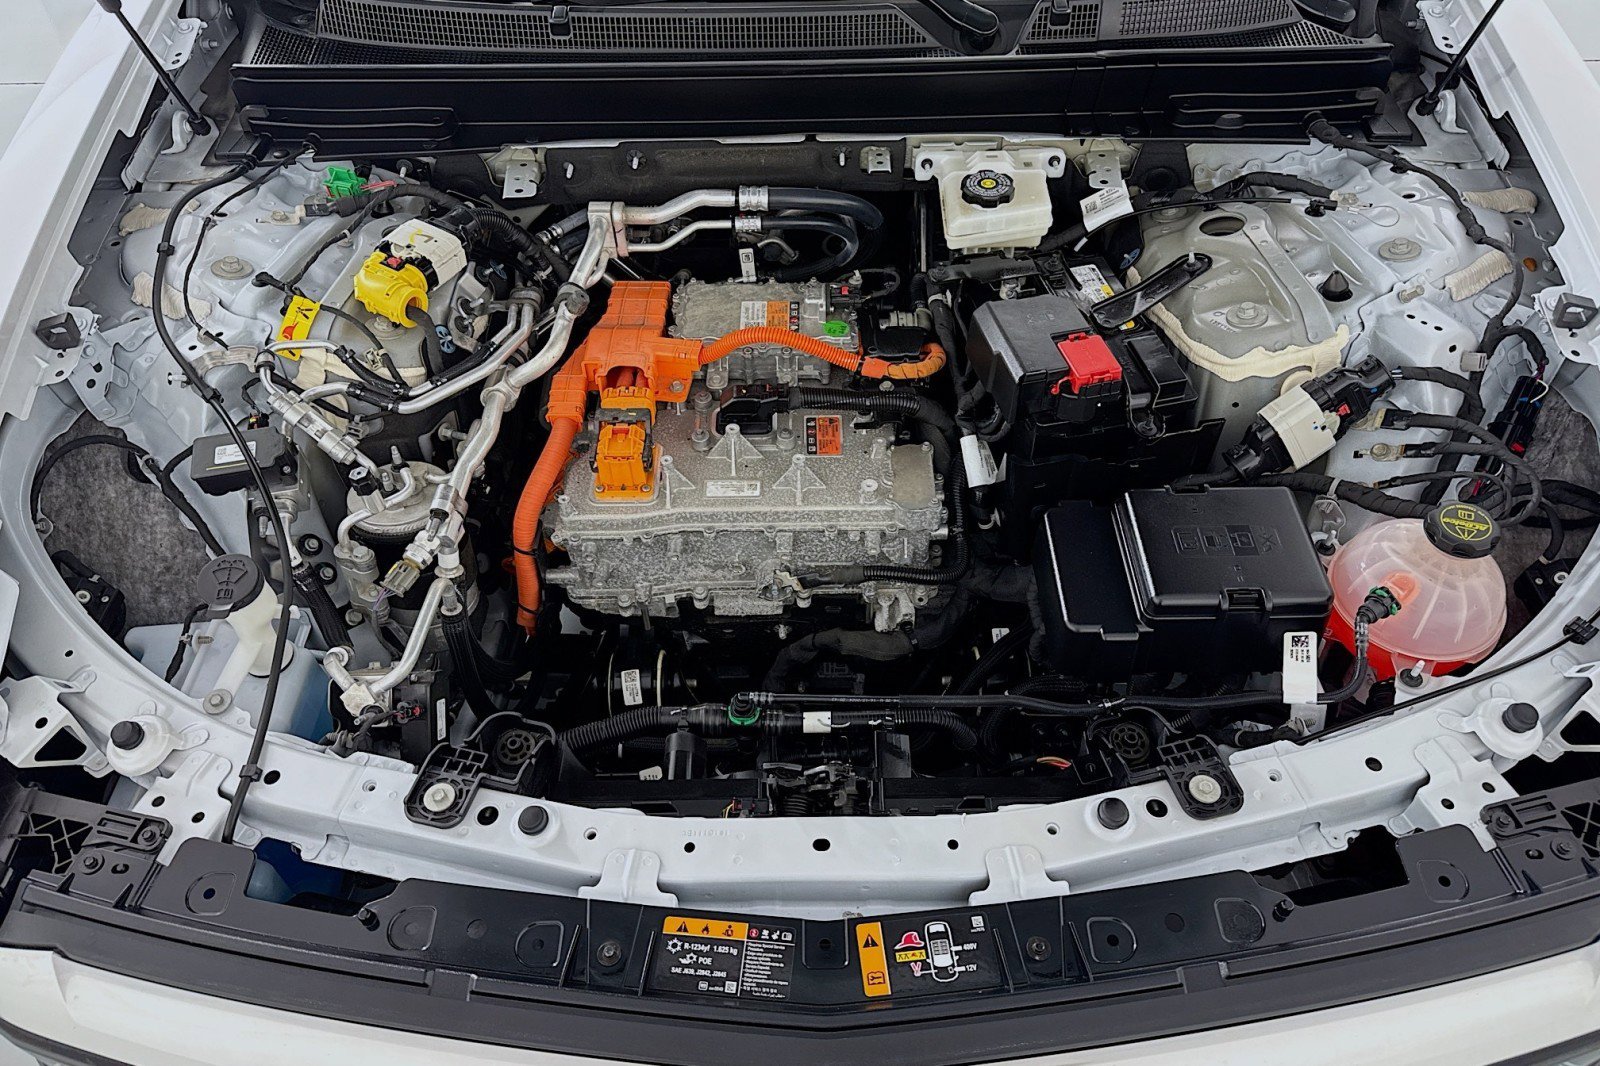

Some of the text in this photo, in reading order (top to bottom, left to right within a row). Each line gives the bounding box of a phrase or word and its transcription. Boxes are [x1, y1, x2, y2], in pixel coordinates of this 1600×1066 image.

[684, 942, 738, 956] R-1234yf 1.625 kg
[698, 957, 712, 965] POE
